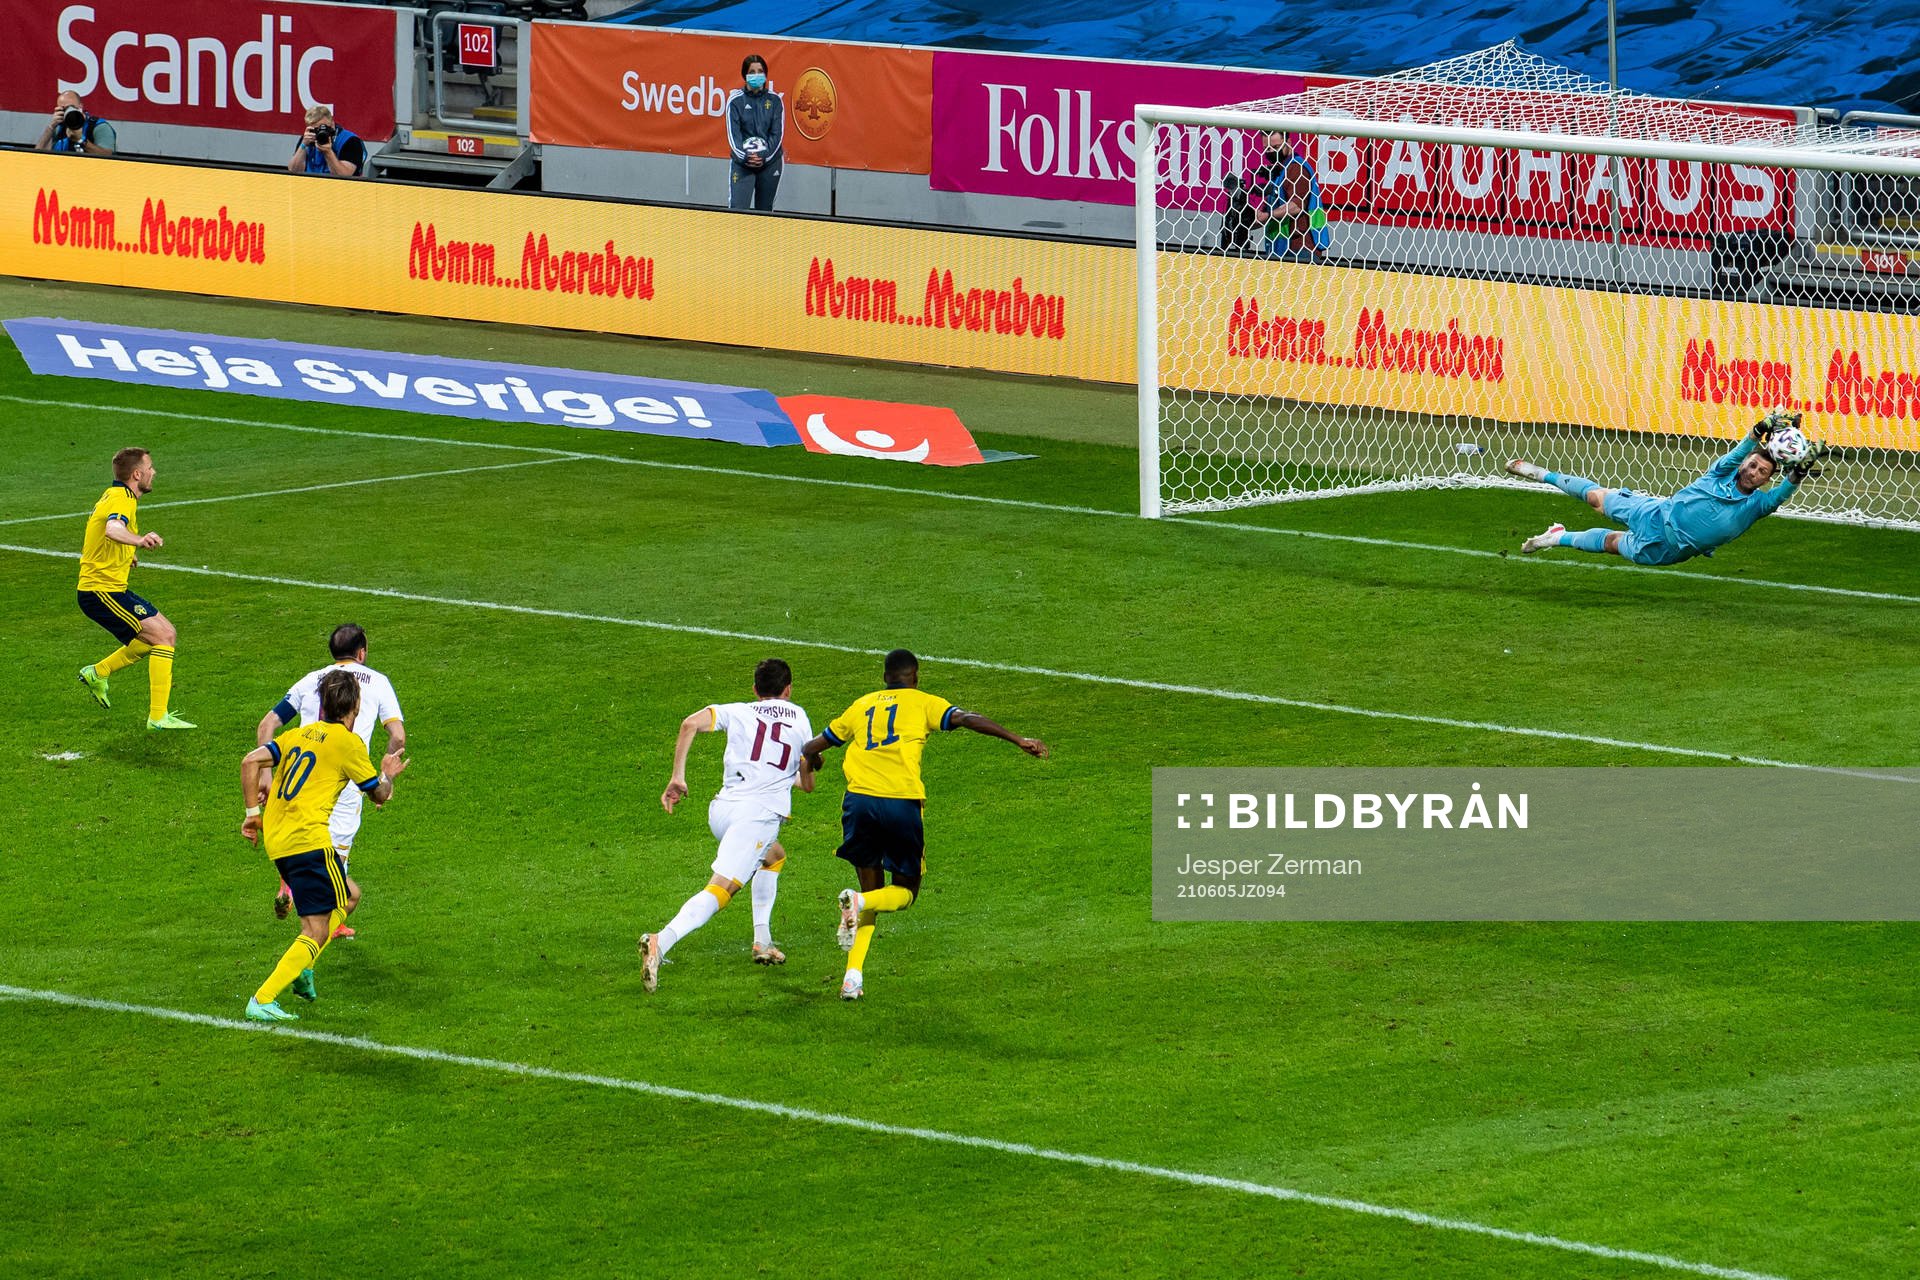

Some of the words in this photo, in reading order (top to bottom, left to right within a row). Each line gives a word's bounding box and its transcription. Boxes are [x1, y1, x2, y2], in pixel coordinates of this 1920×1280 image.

[57, 5, 334, 114] Scandic
[464, 33, 489, 53] 102
[621, 70, 785, 118] Swedb
[456, 138, 475, 153] 102
[981, 83, 1244, 188] Folksam
[1316, 109, 1776, 218] BAUHAUS
[33, 188, 266, 265] Mmm...Marabou
[409, 221, 655, 301] Mmm...Marabou
[1873, 254, 1894, 269] 101
[805, 256, 1066, 340] Mmm...Marabou
[55, 333, 283, 388] Heja
[293, 358, 713, 428] Sverige!
[750, 717, 792, 771] 15
[865, 704, 899, 750] 11
